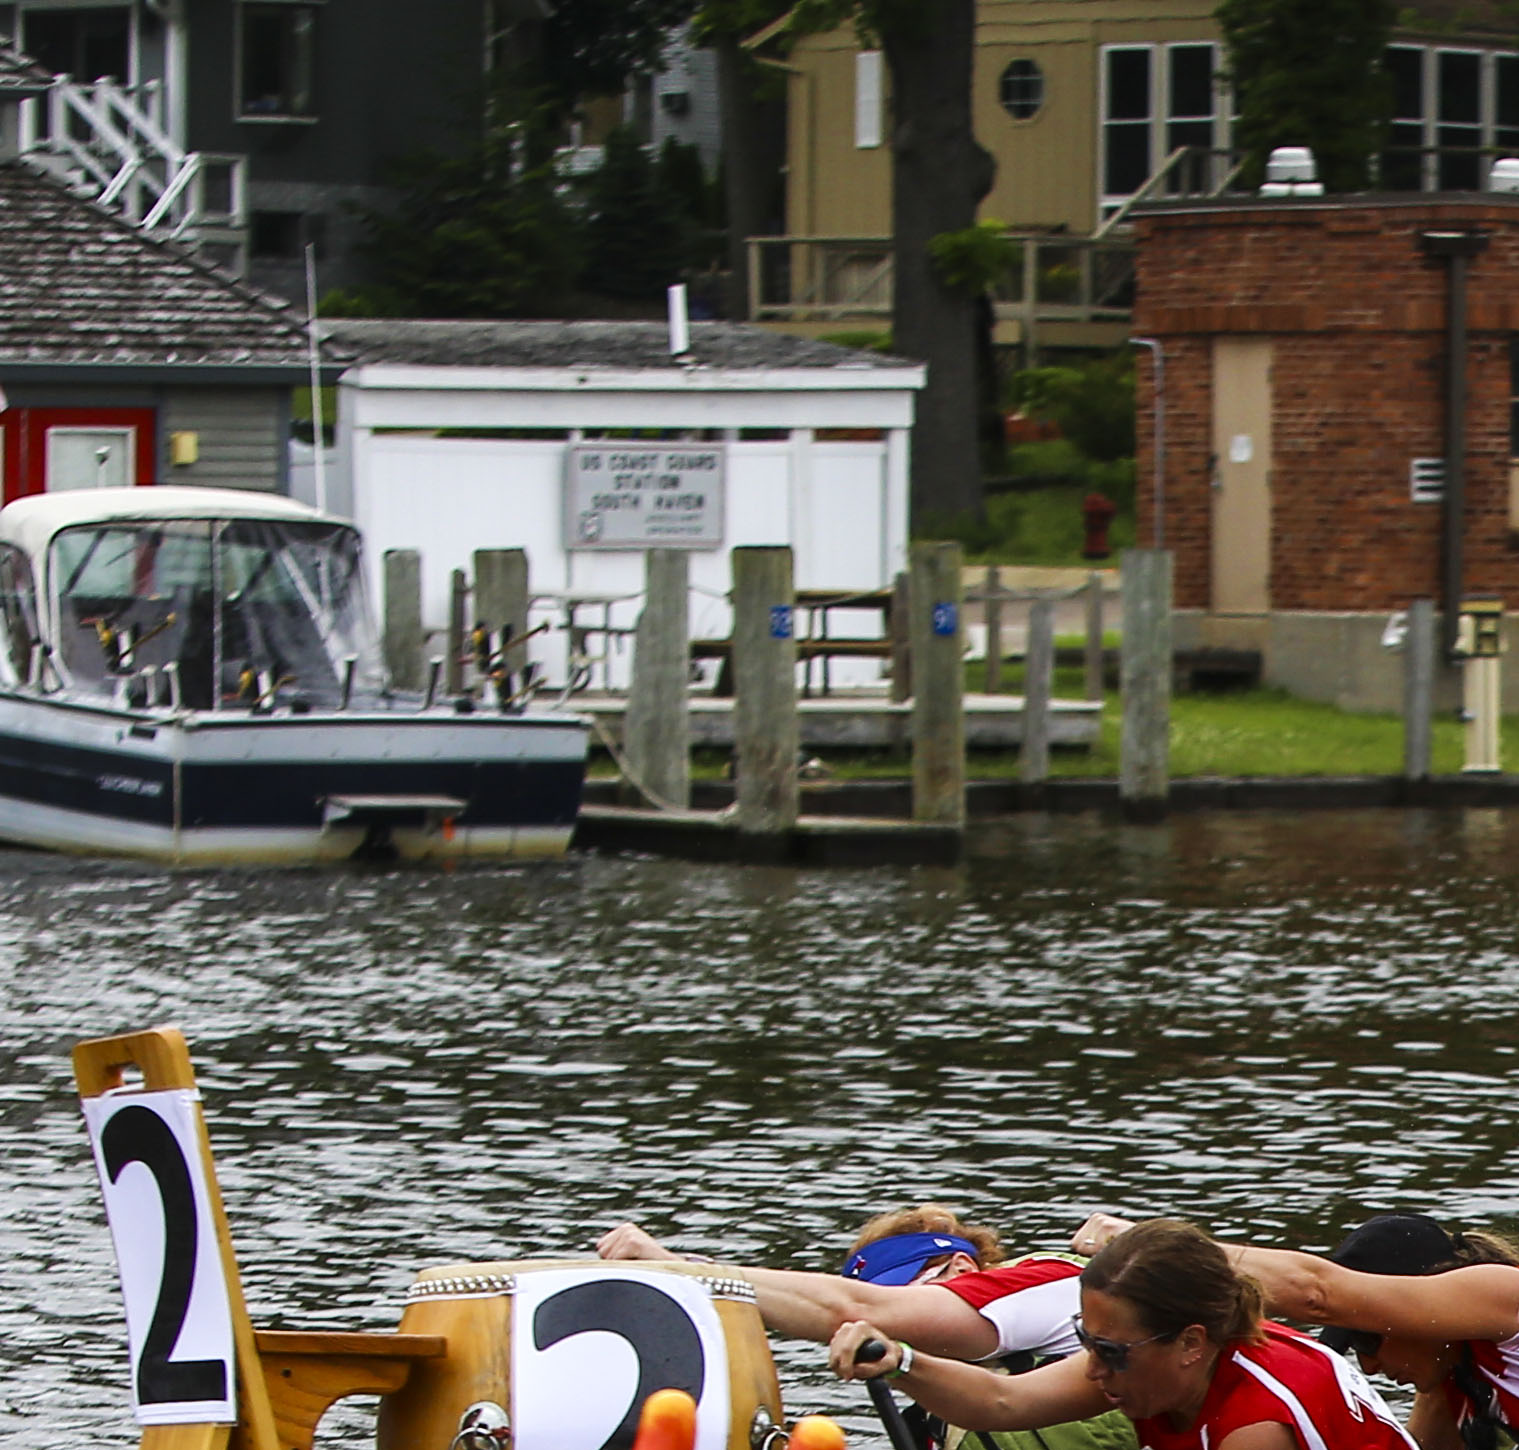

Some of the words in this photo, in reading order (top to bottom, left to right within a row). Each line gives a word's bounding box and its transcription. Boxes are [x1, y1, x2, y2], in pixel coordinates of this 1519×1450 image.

[609, 454, 658, 470] COAST
[666, 454, 718, 470] GUARD
[614, 473, 681, 490] STATION
[591, 492, 641, 509] SOUTH
[655, 492, 706, 509] HAVEN
[101, 1105, 228, 1406] 2
